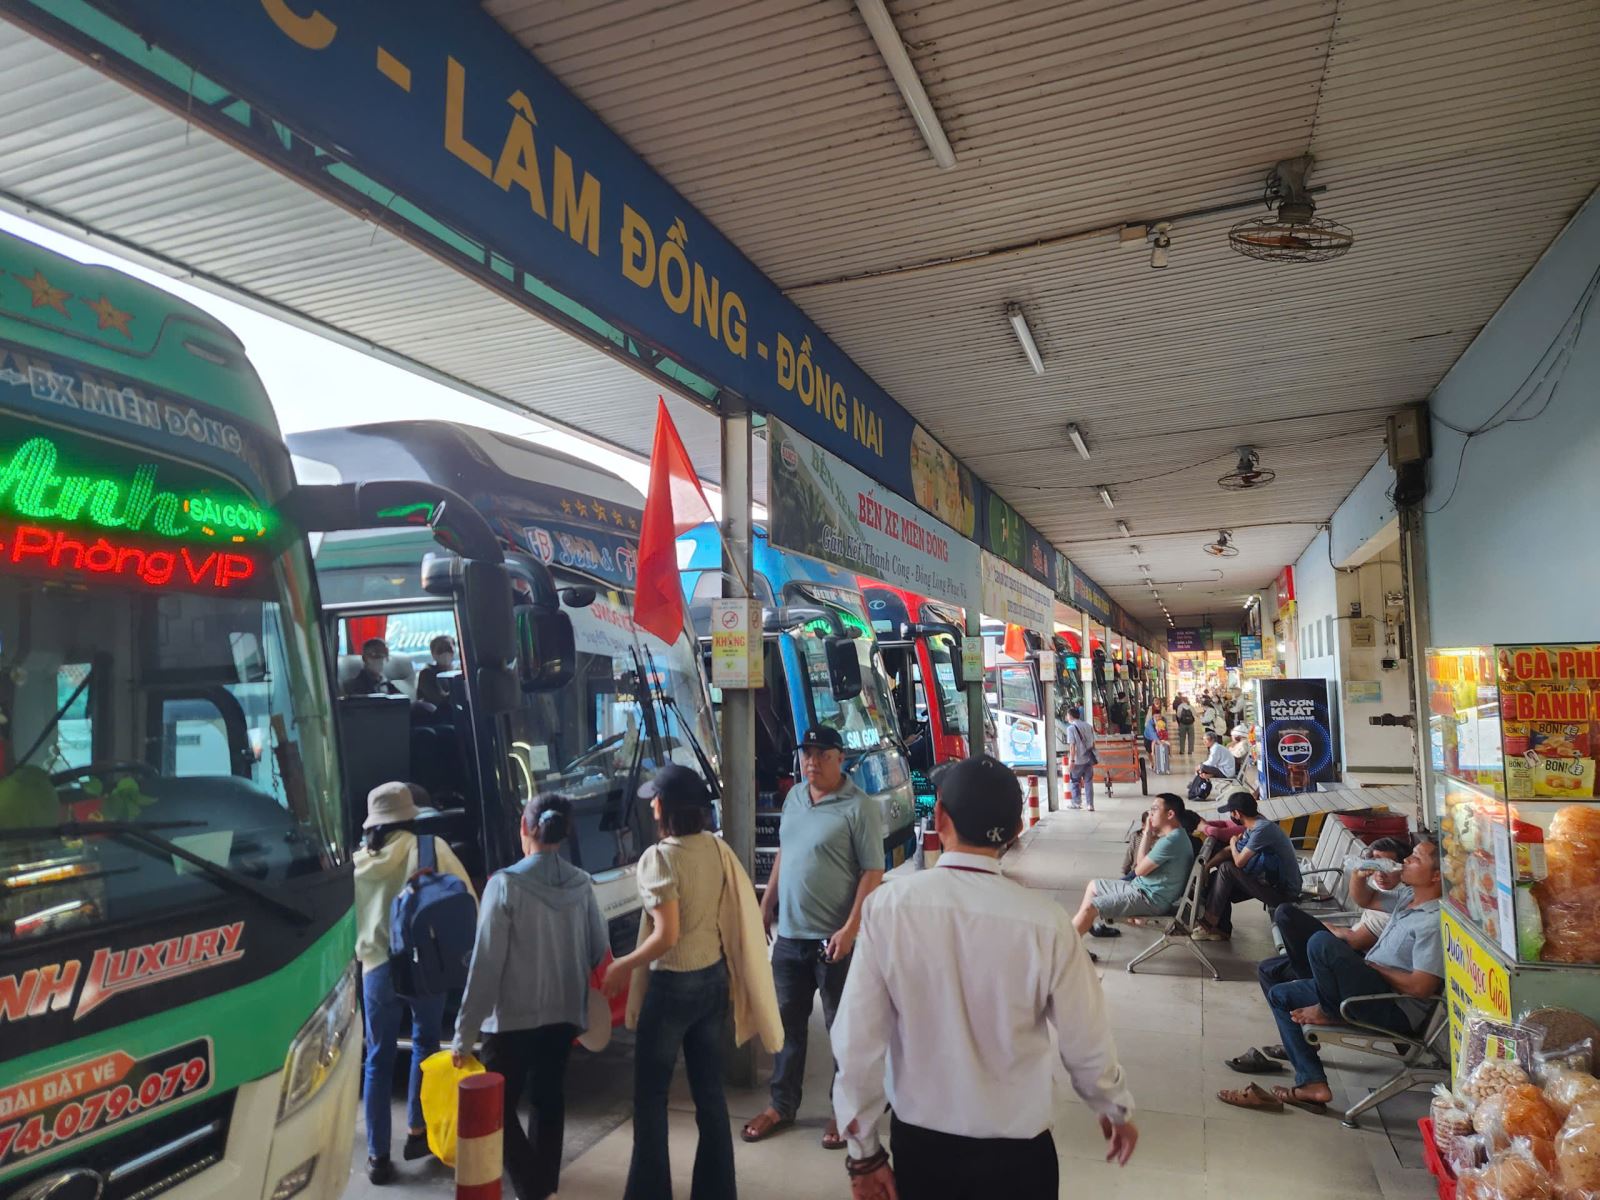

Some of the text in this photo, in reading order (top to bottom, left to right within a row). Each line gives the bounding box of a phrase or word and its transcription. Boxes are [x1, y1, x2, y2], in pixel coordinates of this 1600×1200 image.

[444, 54, 601, 257] LÂM
[620, 203, 748, 360] ĐỒNG
[776, 332, 848, 432] ĐỒNG
[853, 397, 884, 457] NAI
[858, 488, 882, 531] BẾN
[885, 507, 898, 540] XE
[180, 547, 254, 587] VIP
[1515, 644, 1600, 680] CÀ PH
[1270, 706, 1315, 716] KHÁT
[1280, 745, 1311, 753] PEPSI
[1545, 759, 1568, 773] BON!
[0, 920, 245, 1022] NH LUXURY
[92, 1057, 117, 1084] VÉ
